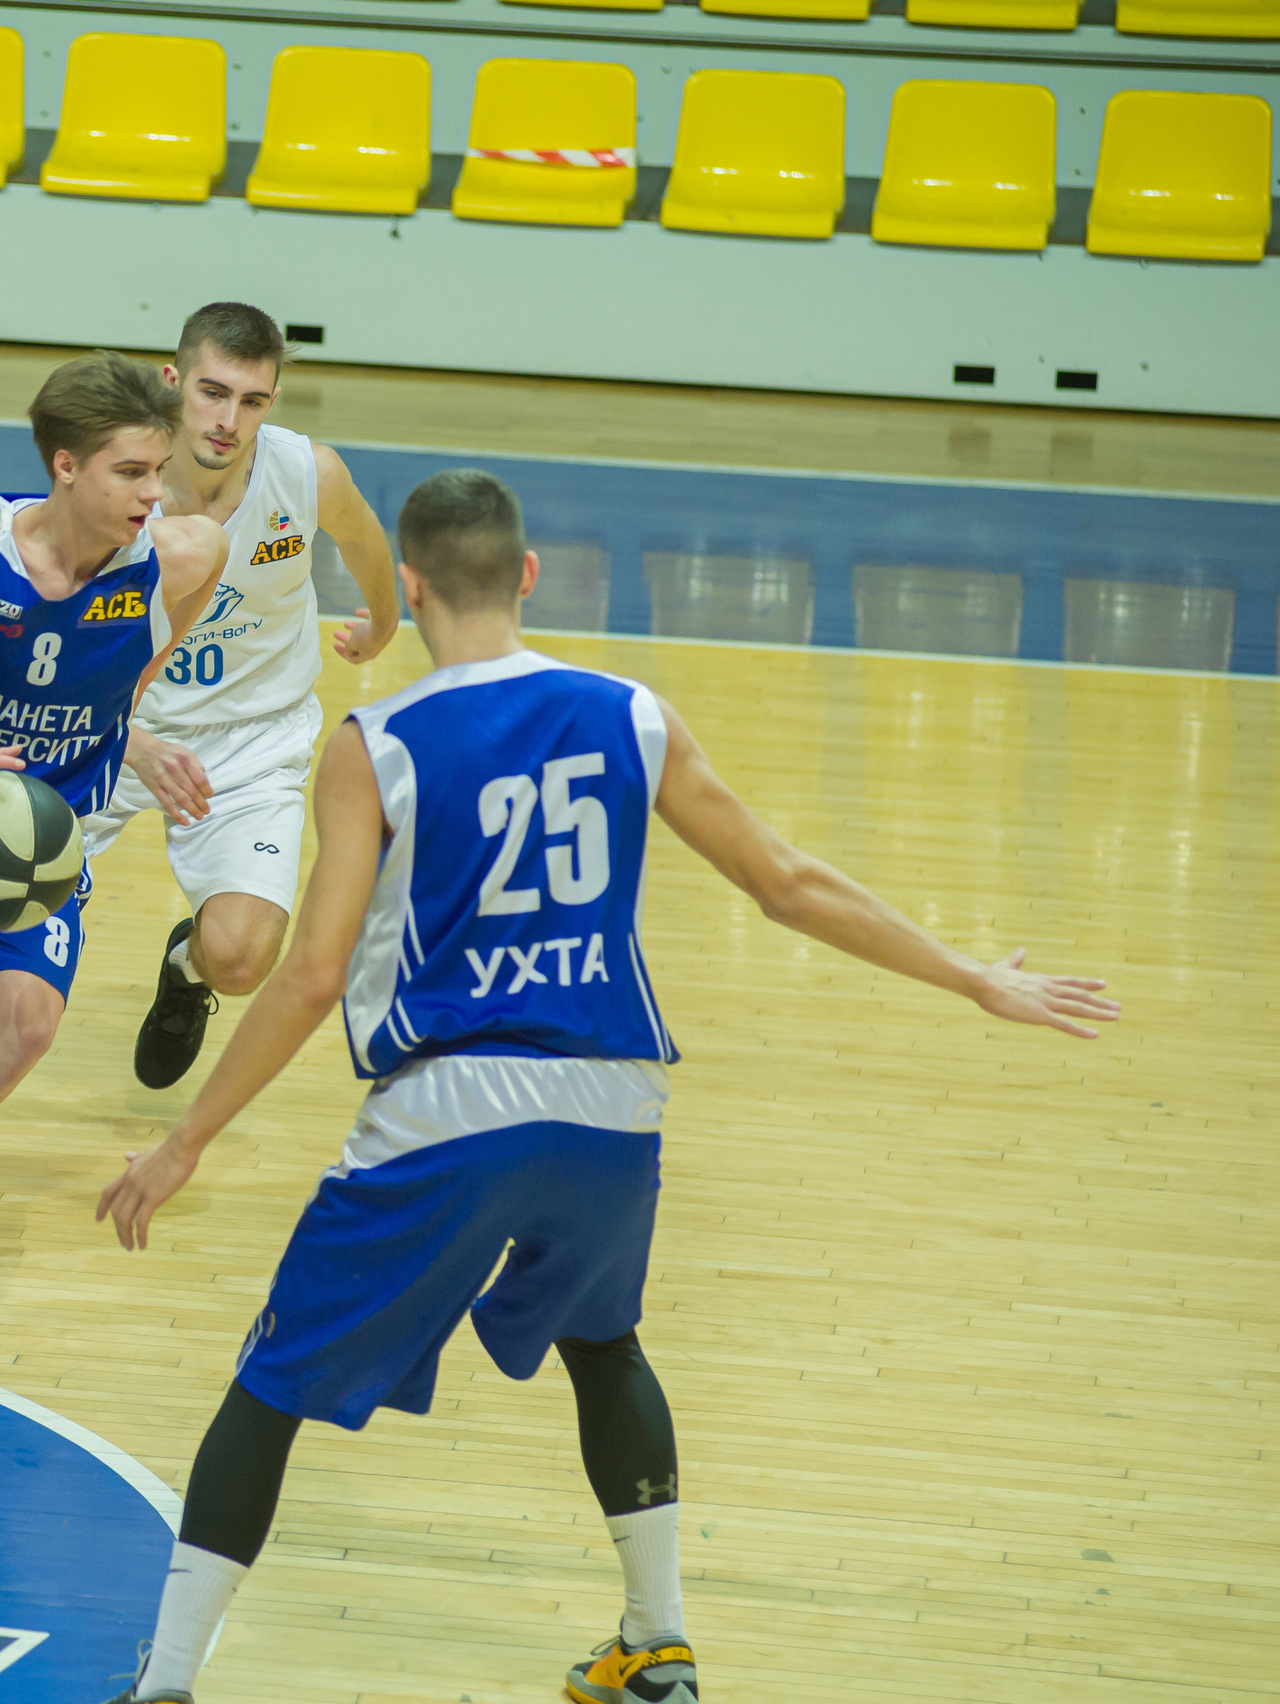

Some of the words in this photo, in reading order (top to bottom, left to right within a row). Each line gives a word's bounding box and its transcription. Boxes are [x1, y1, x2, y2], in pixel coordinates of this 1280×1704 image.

[26, 632, 63, 687] 8
[165, 643, 224, 687] 30
[477, 752, 611, 917] 25
[43, 915, 70, 968] 8
[463, 932, 611, 999] УХТА
